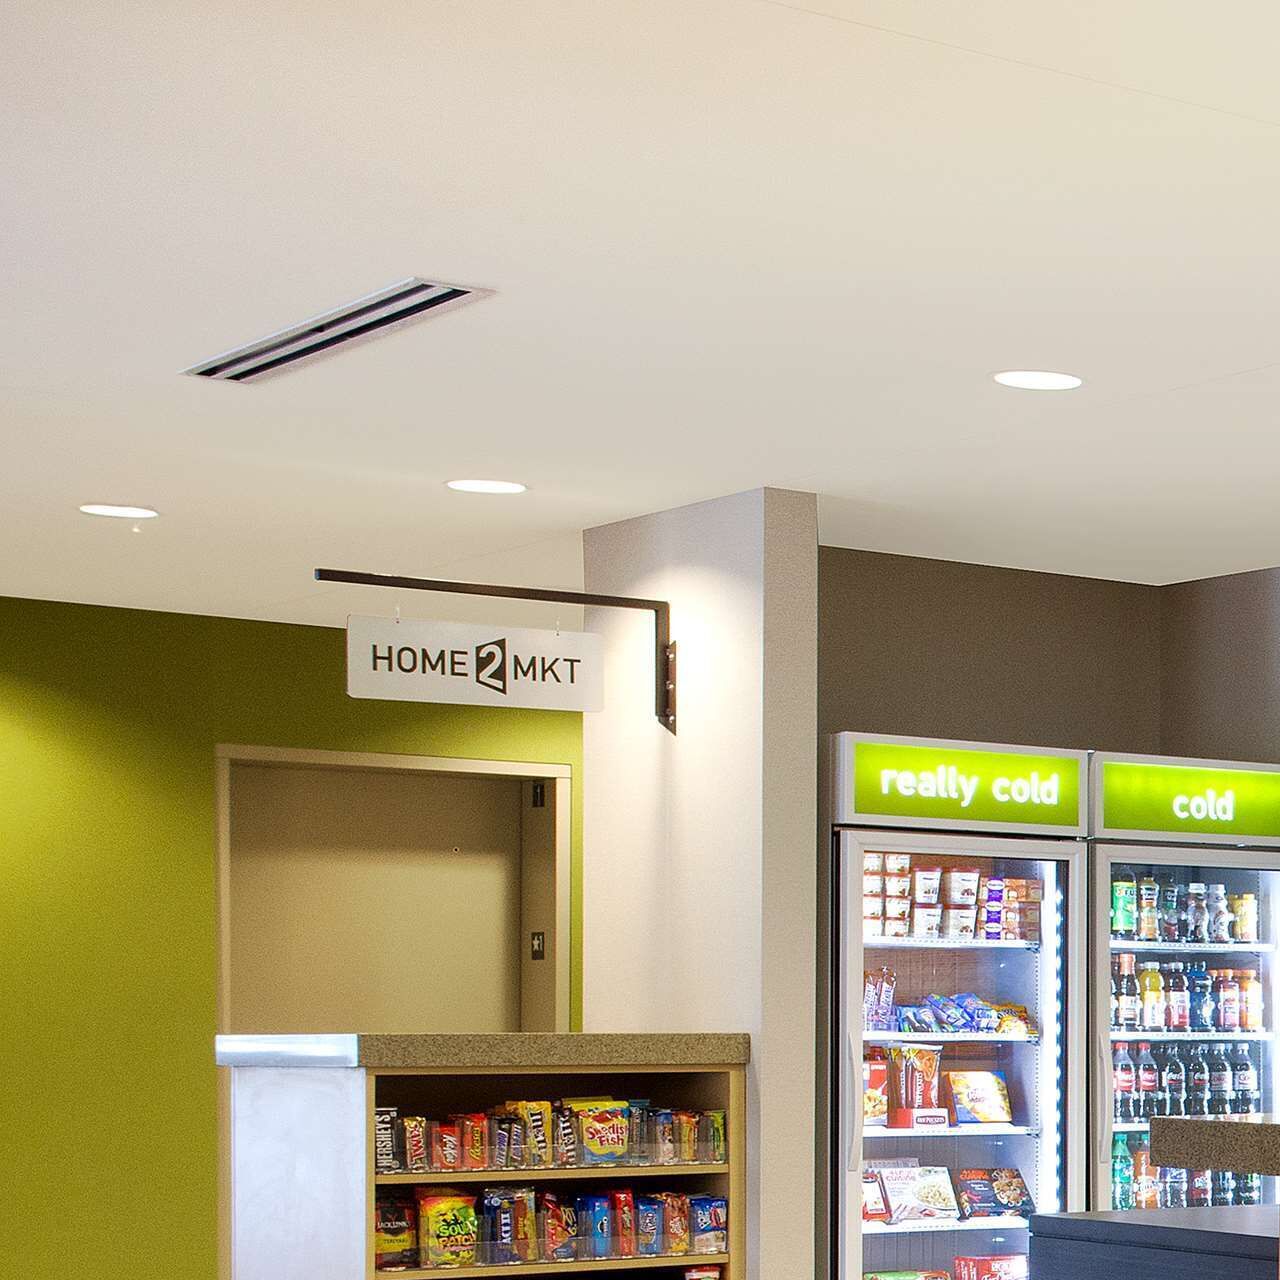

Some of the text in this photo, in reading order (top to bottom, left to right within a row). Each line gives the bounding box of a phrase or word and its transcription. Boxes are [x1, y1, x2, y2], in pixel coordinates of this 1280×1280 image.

[513, 655, 581, 684] MKT
[880, 764, 1061, 808] really cold
[1172, 789, 1234, 821] cold
[596, 1135, 624, 1147] Fish
